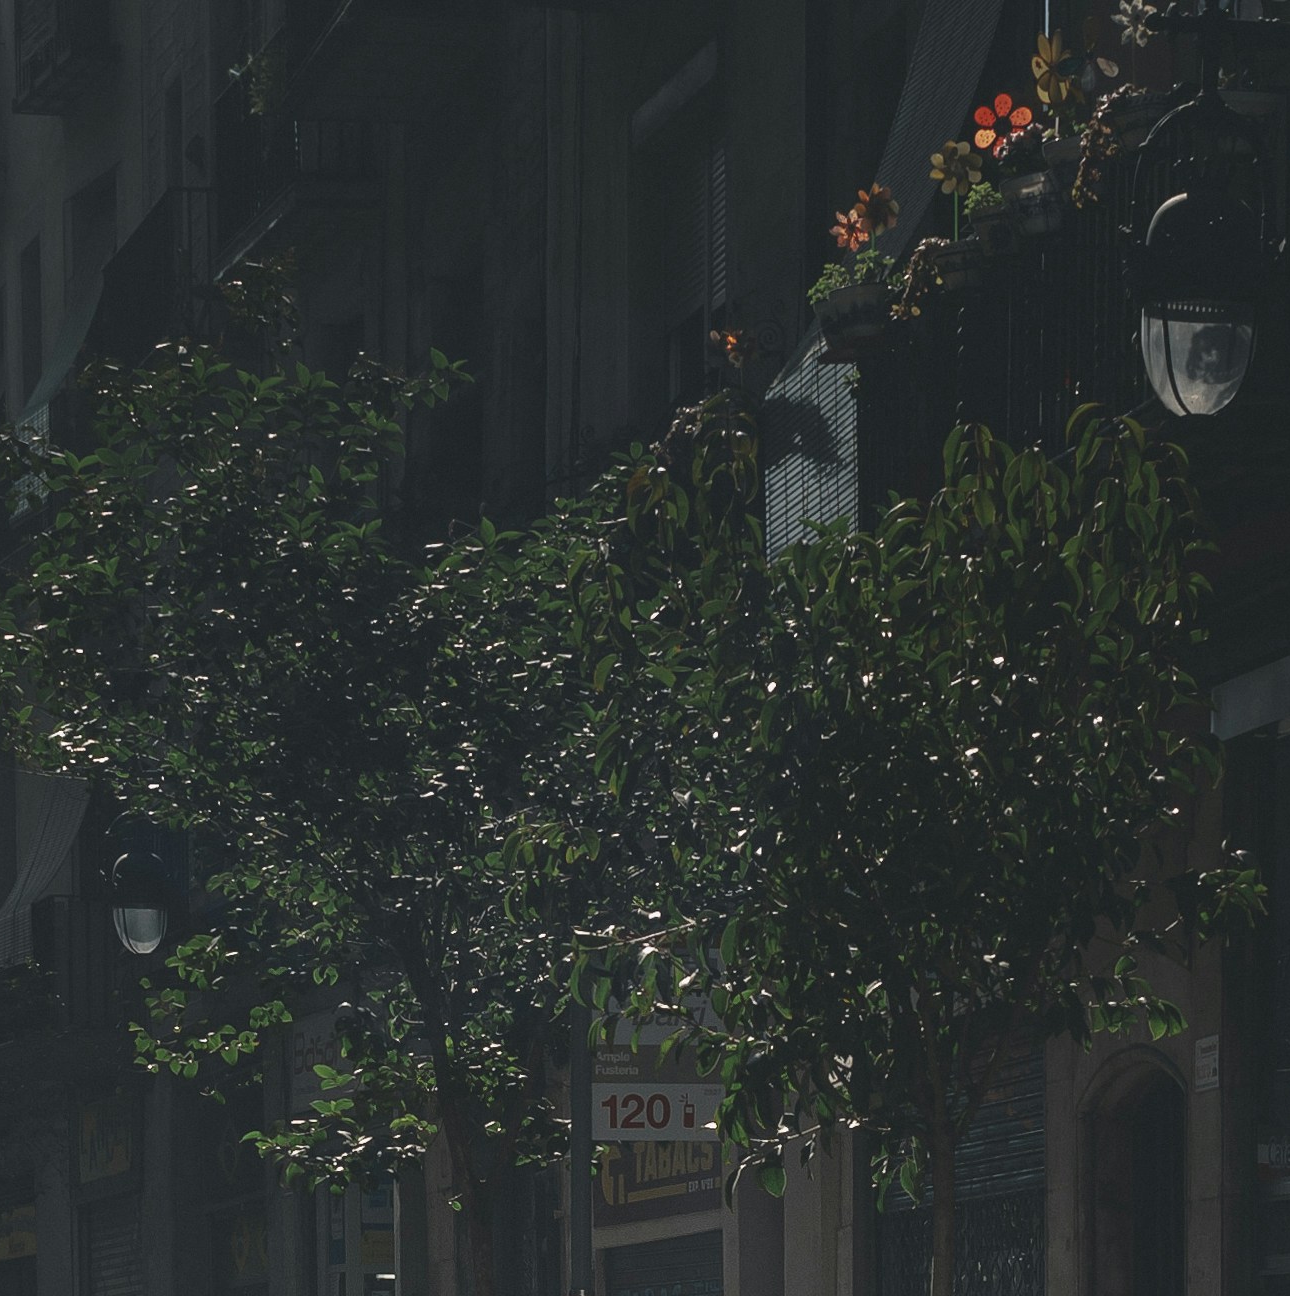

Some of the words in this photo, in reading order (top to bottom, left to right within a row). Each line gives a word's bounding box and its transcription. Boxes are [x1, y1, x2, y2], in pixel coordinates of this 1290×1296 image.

[596, 1051, 631, 1064] Ample
[601, 1093, 671, 1129] 120
[634, 1141, 714, 1184] TABACS
